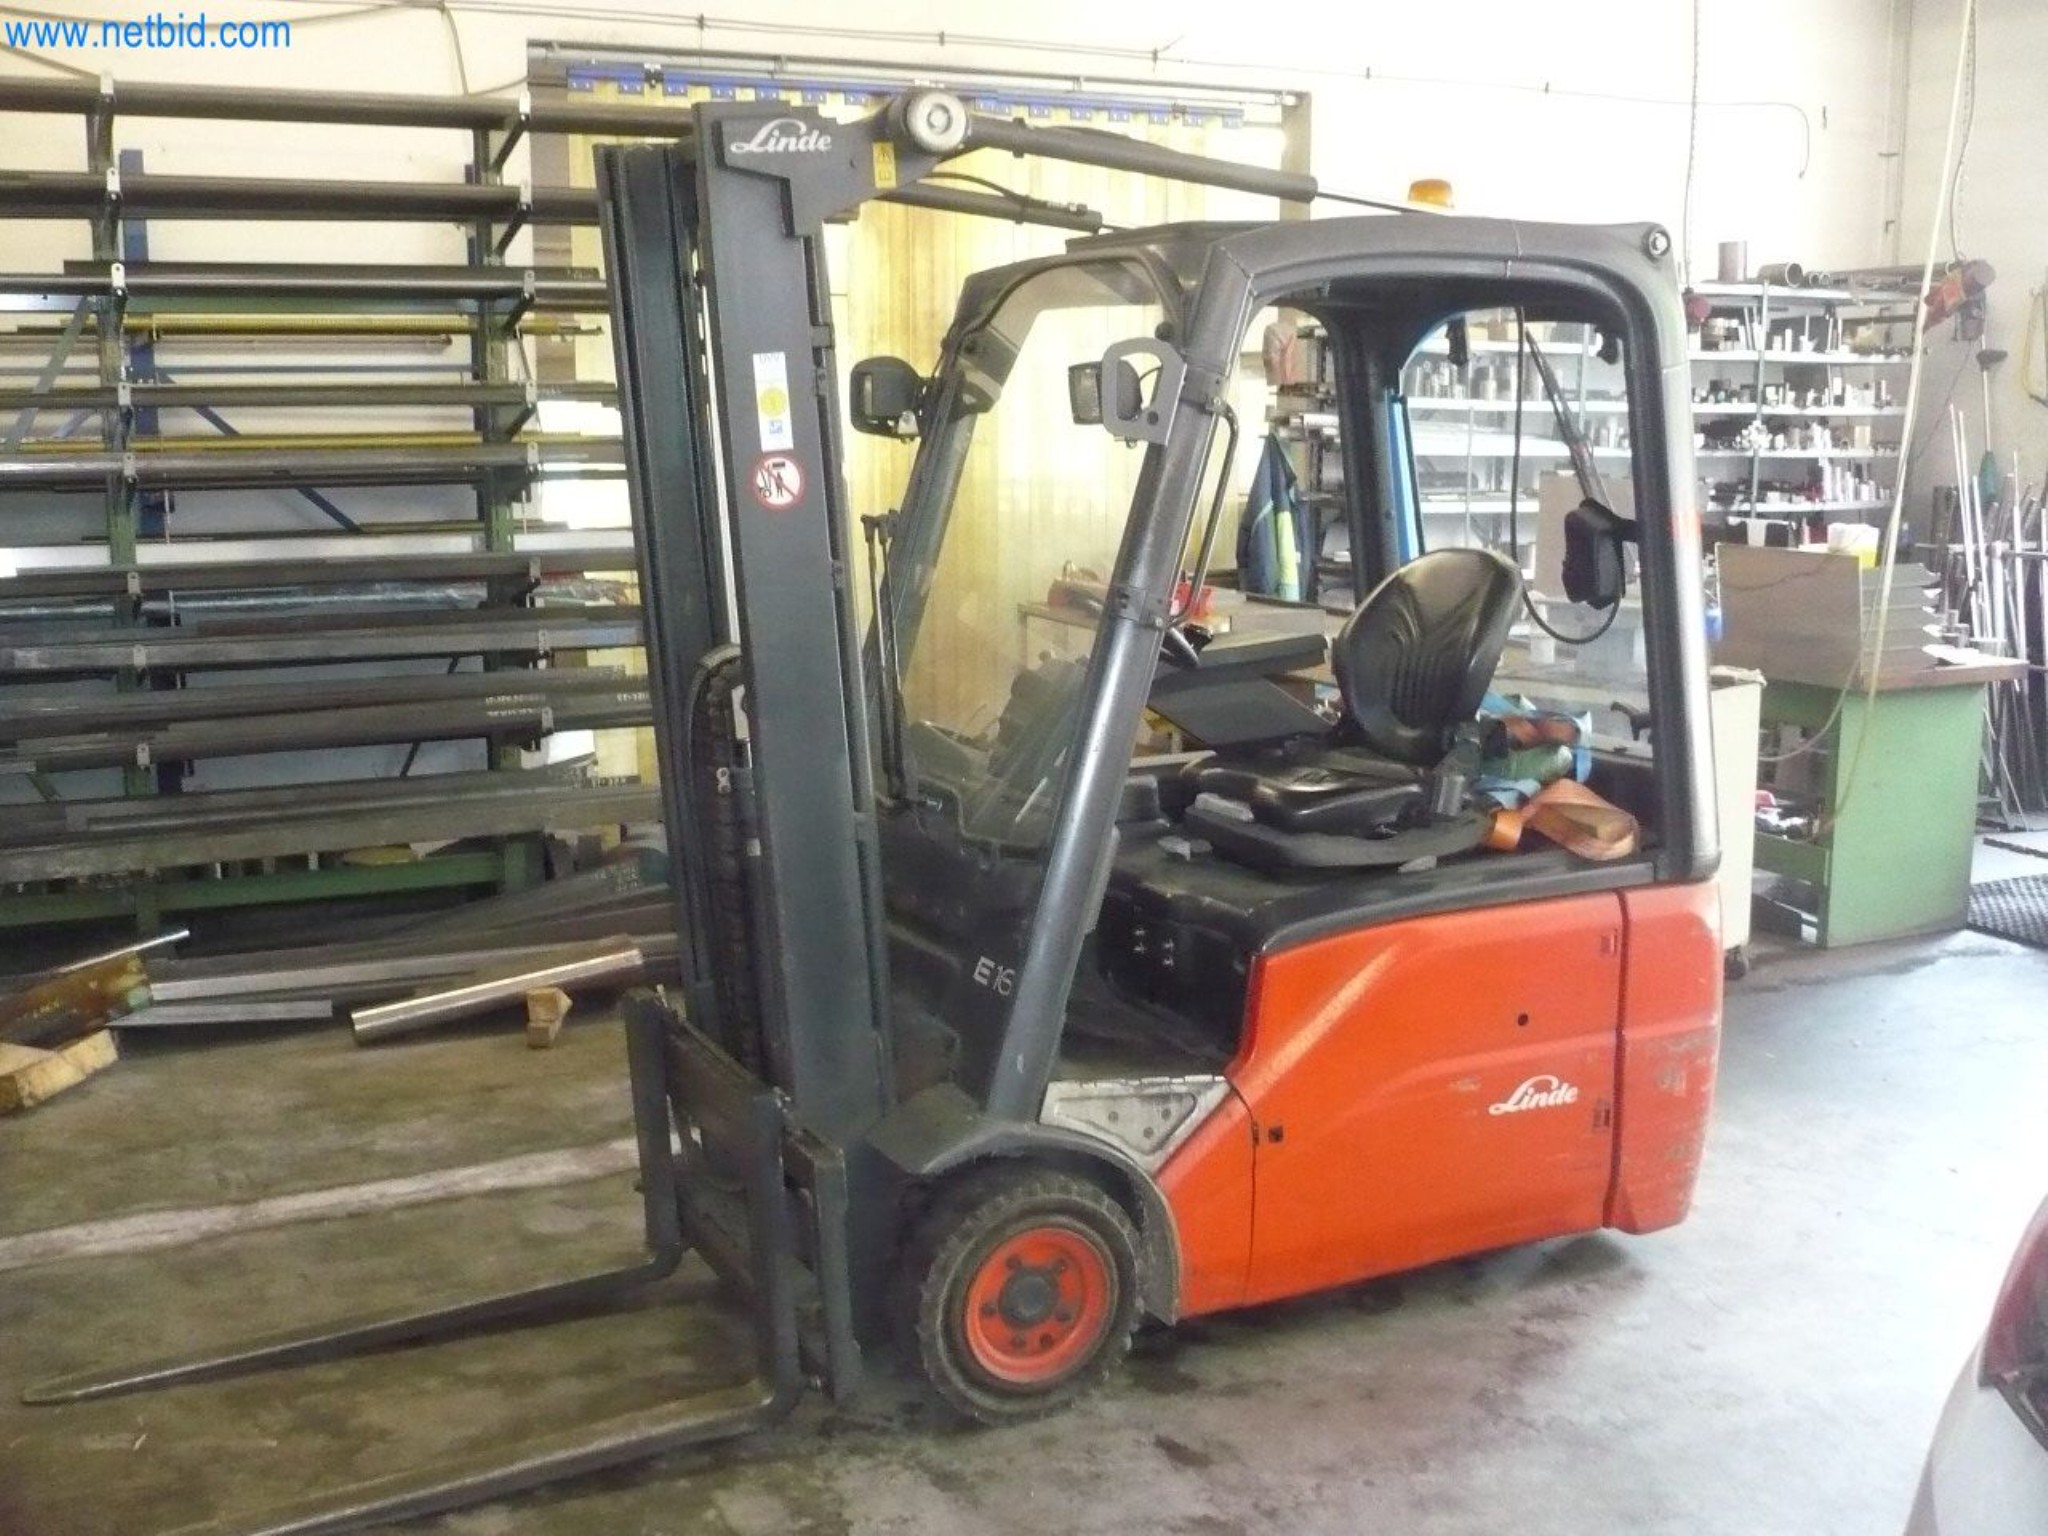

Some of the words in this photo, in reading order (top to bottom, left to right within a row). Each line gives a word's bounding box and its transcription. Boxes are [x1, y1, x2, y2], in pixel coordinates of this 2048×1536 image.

[730, 118, 832, 154] Linde
[972, 955, 1015, 996] E16
[1488, 1074, 1578, 1116] Linde
